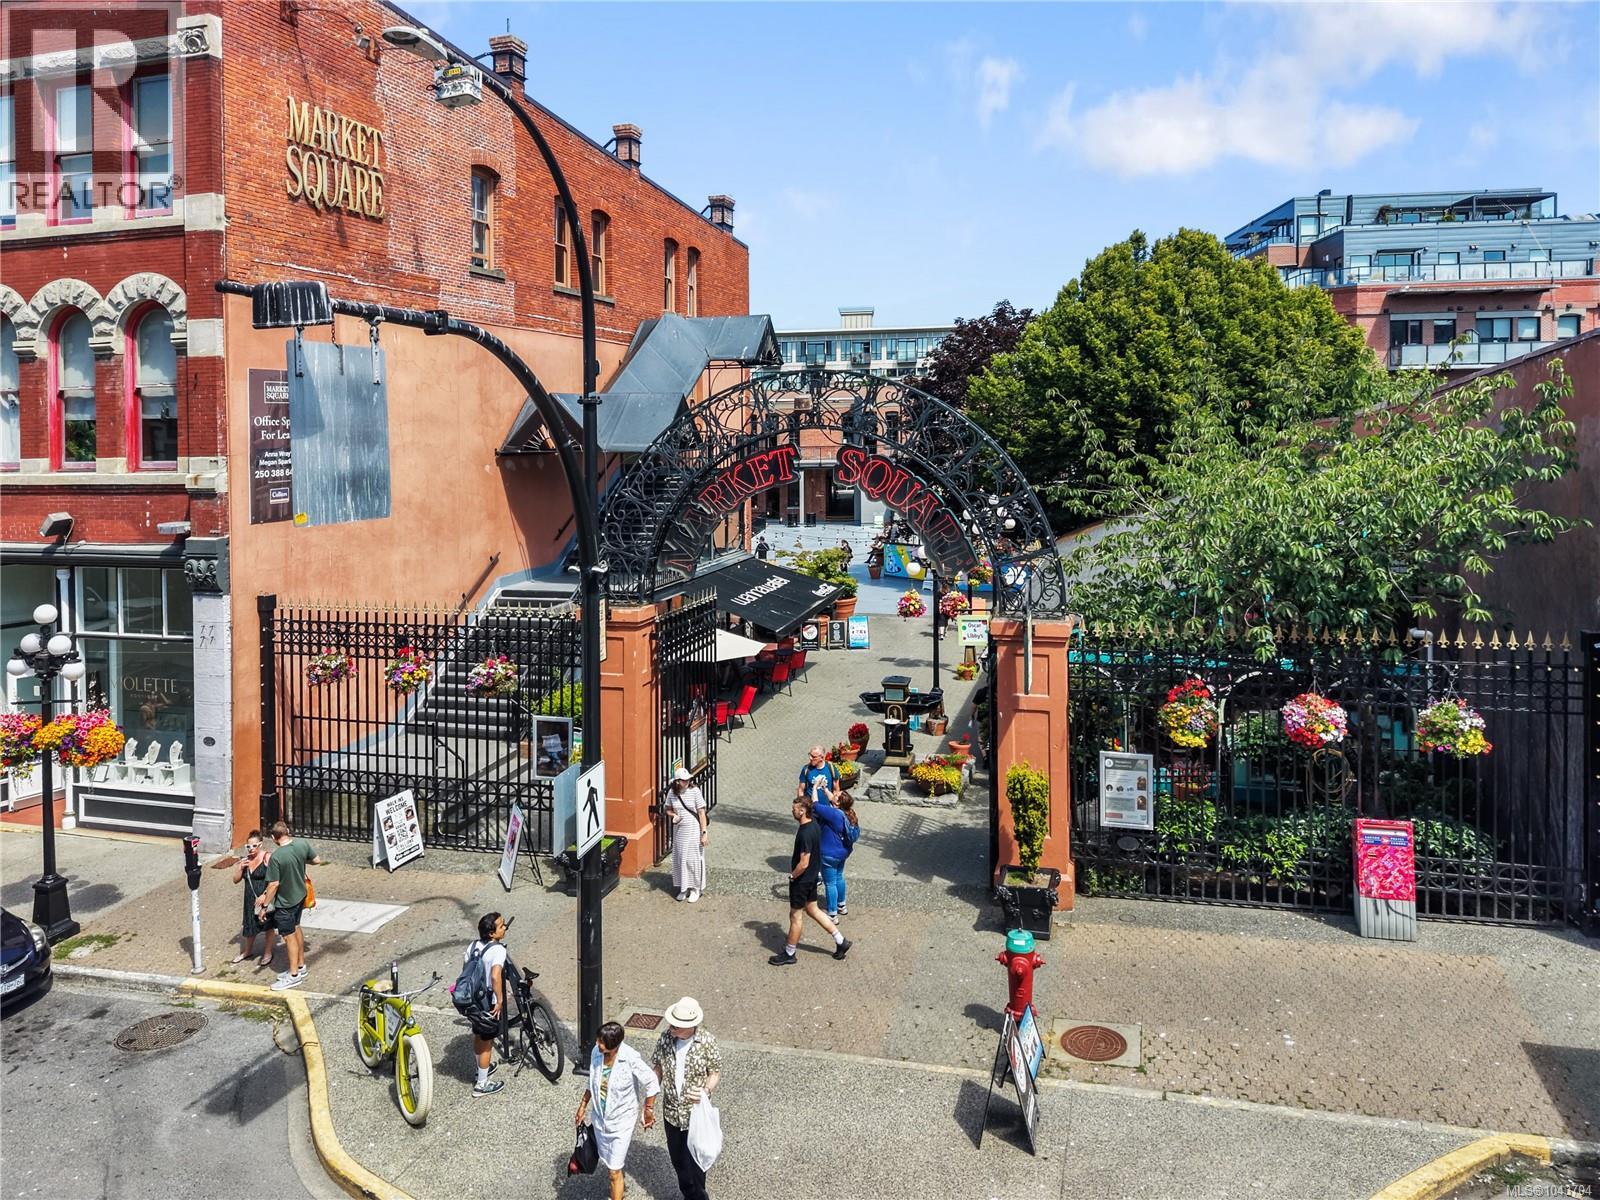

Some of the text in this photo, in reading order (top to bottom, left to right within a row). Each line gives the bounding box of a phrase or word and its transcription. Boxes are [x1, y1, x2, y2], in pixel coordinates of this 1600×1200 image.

[286, 95, 384, 169] MARKET
[285, 145, 385, 218] SQUARE
[266, 392, 289, 400] SQUAR
[254, 415, 280, 426] Office
[261, 430, 291, 440] For Lea
[255, 469, 270, 478] 250
[660, 447, 796, 571] MARKET
[385, 800, 408, 815] WELCOME
